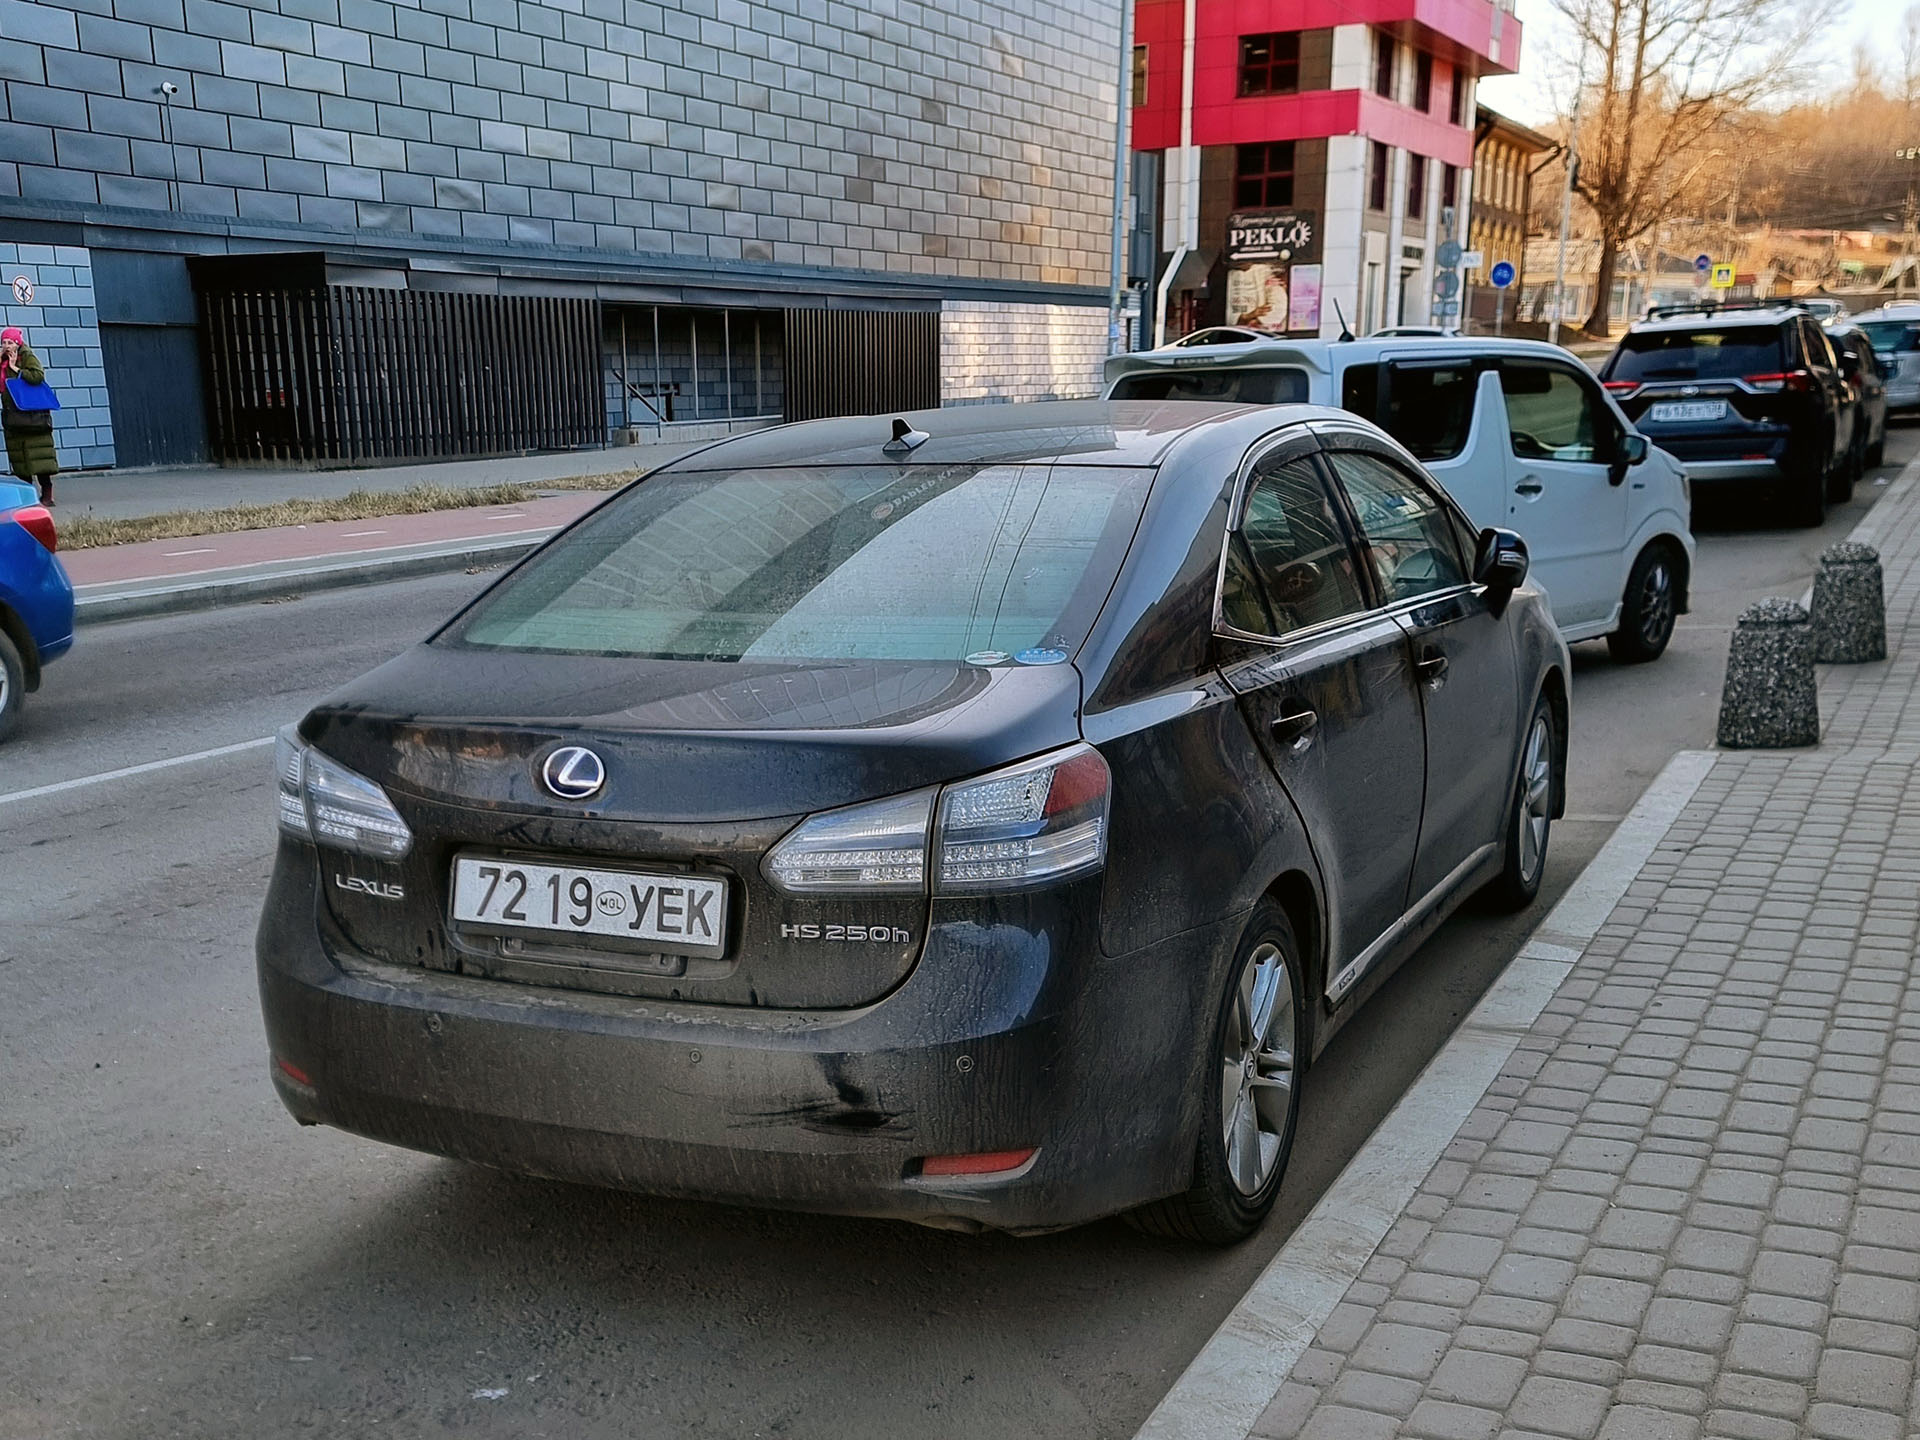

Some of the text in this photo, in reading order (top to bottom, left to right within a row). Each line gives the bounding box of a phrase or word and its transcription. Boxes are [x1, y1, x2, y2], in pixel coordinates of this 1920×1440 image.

[1230, 221, 1311, 249] PEKLO
[335, 873, 404, 899] LEXUS
[599, 898, 622, 911] MGL
[628, 884, 714, 937] УЕК
[780, 923, 910, 943] HS 250h
